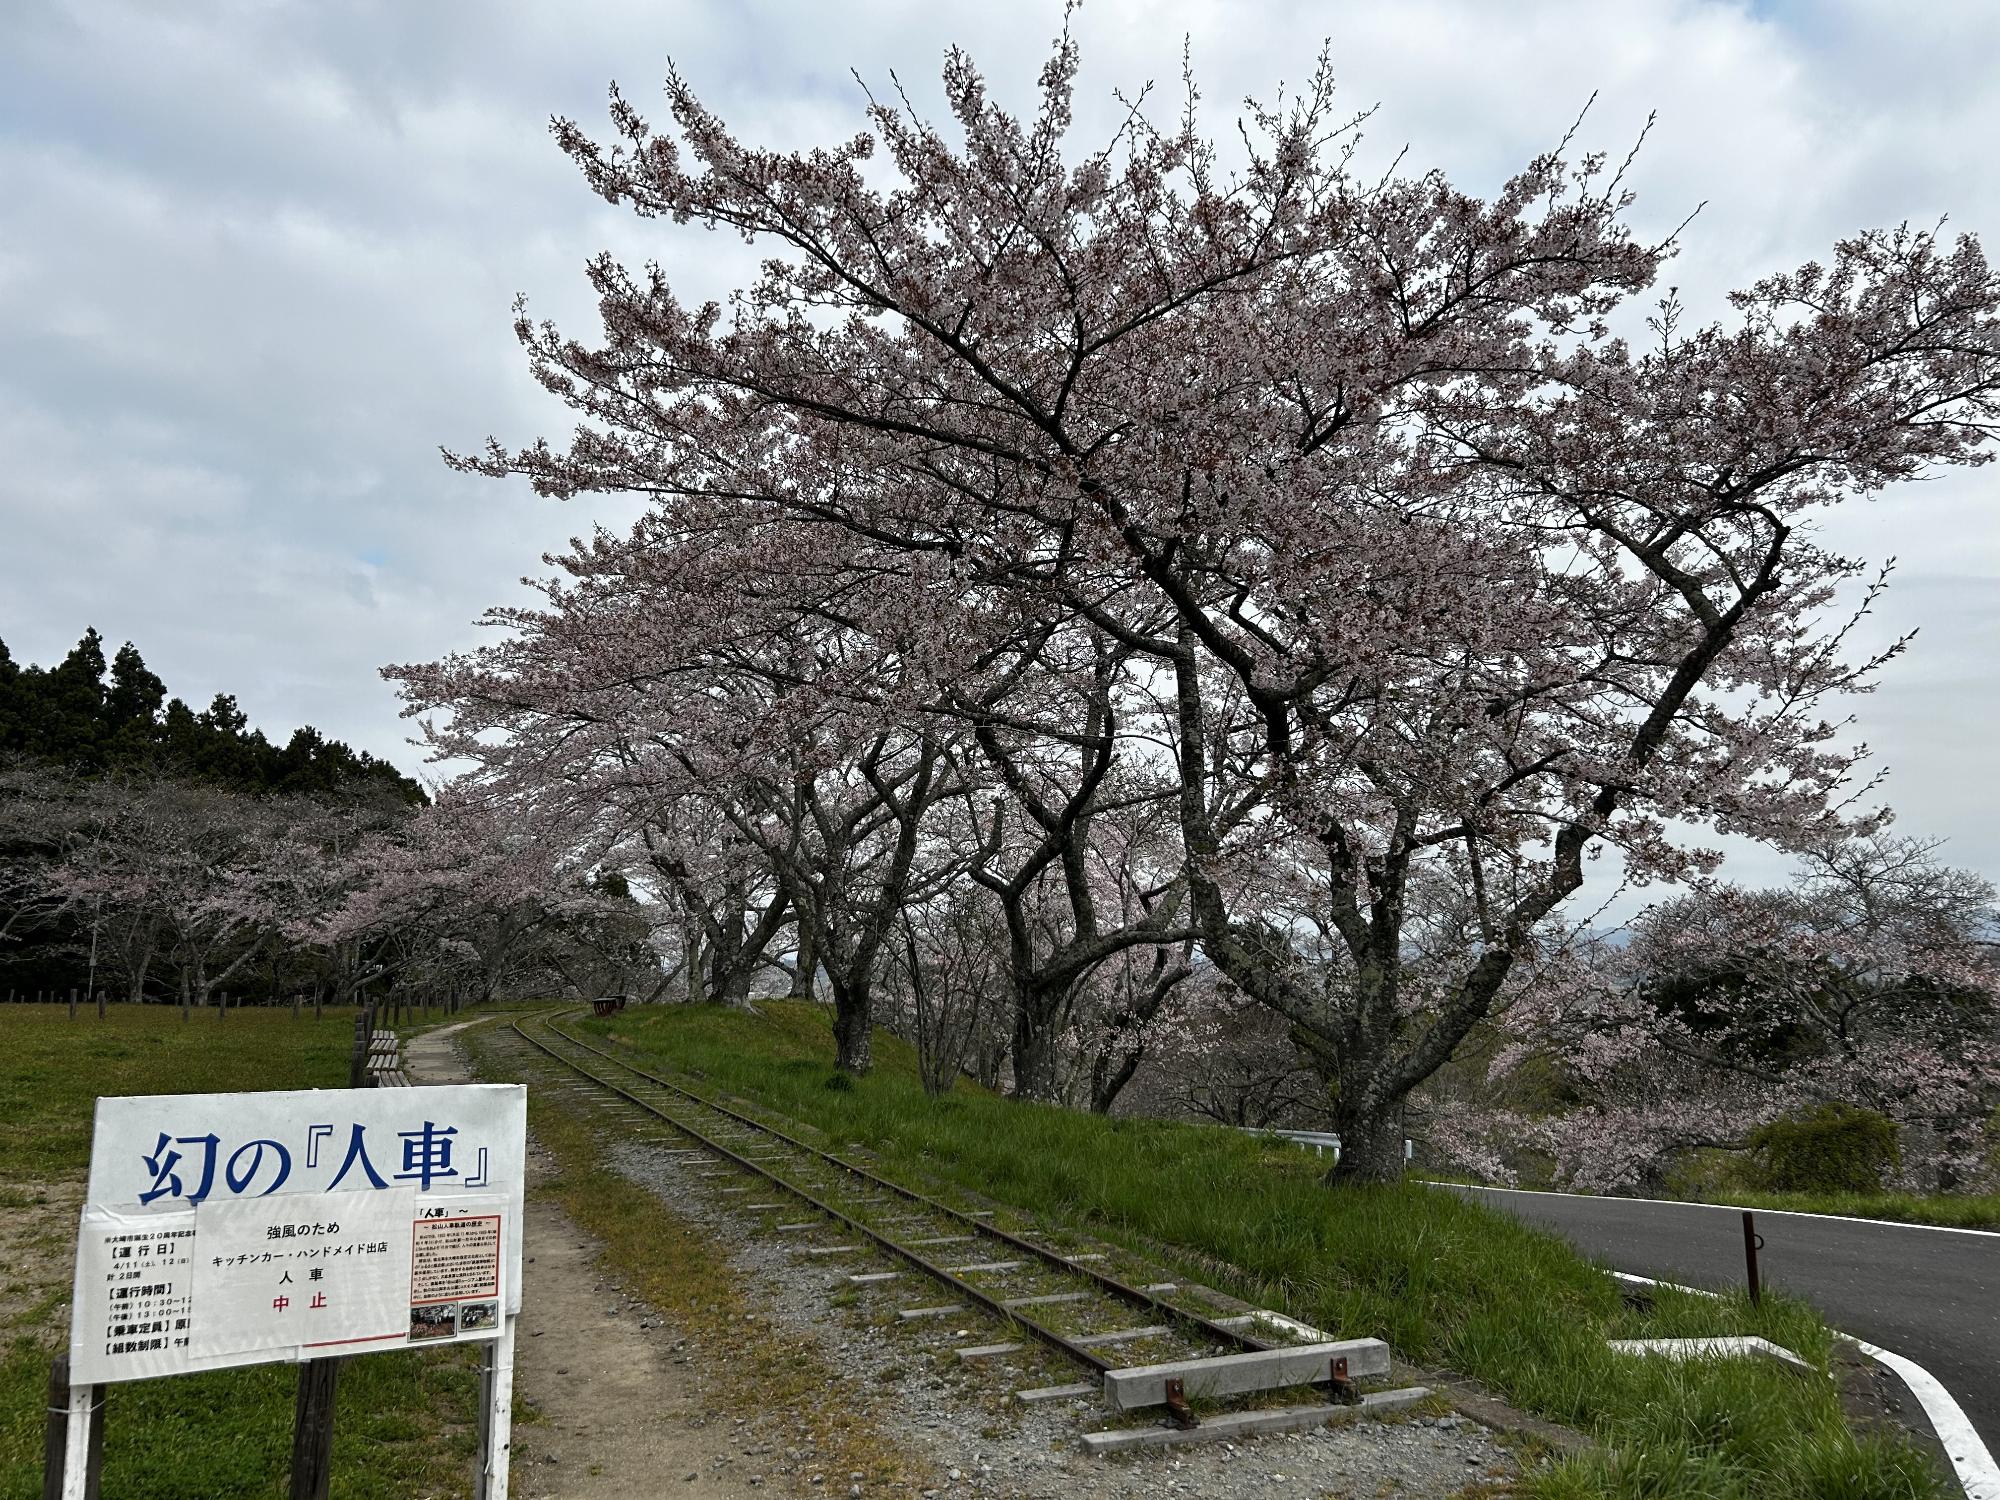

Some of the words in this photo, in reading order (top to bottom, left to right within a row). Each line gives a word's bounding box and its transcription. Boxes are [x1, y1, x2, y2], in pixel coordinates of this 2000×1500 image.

[138, 1121, 488, 1206] 幻の『人車』
[267, 1221, 340, 1240] 強風のため
[212, 1241, 388, 1267] キッチンカー・ハンドメイド出店
[109, 1282, 172, 1300] 【運行時間】
